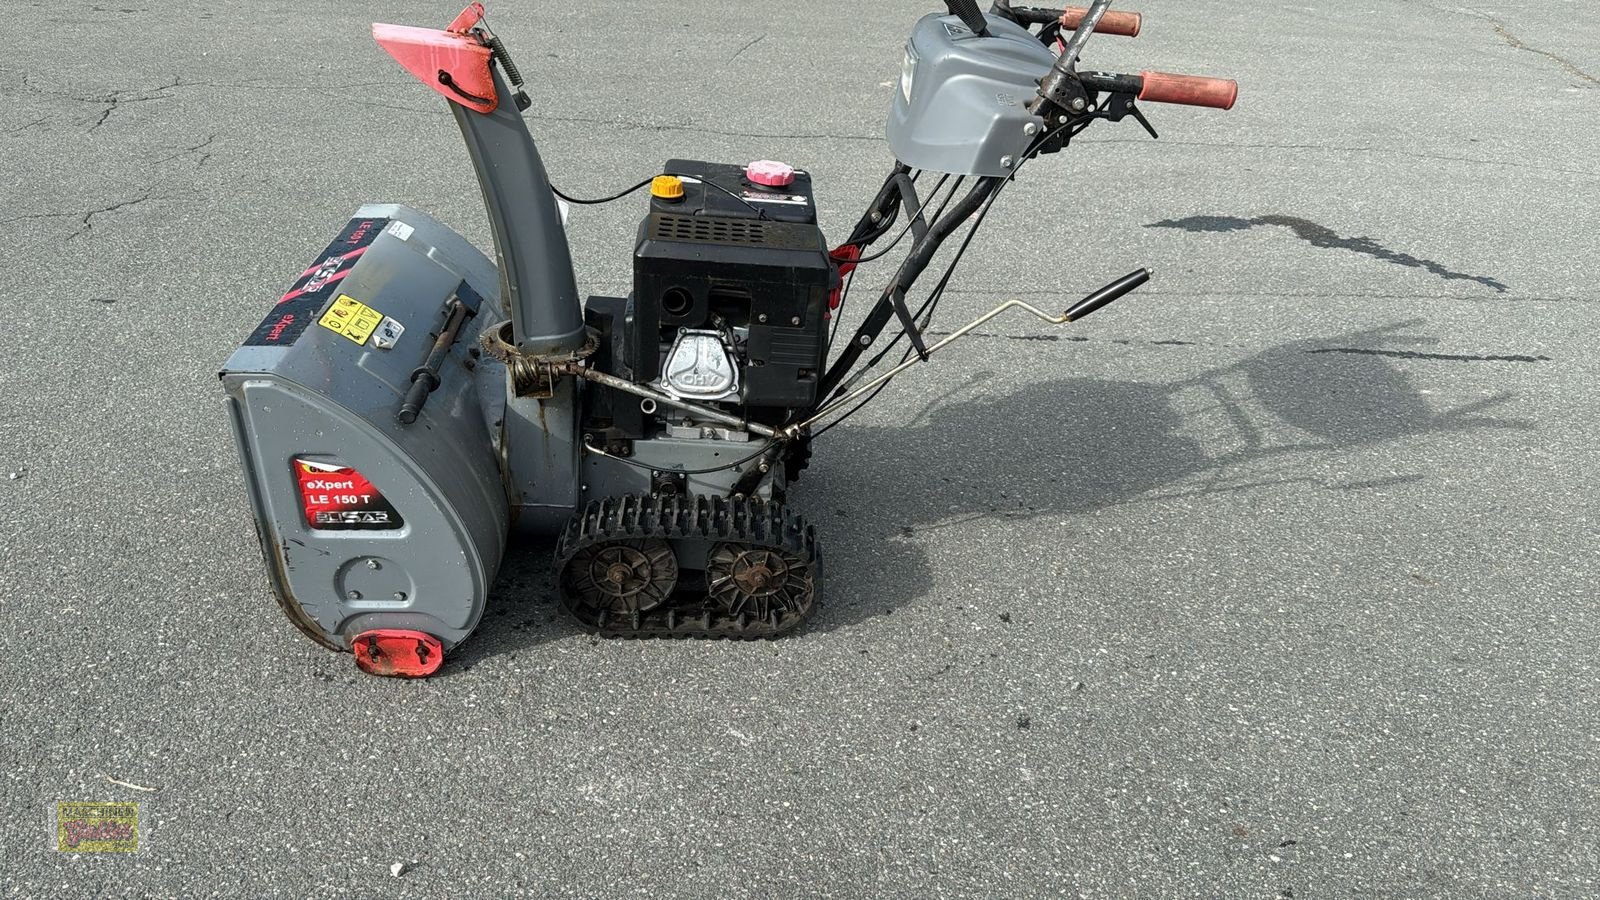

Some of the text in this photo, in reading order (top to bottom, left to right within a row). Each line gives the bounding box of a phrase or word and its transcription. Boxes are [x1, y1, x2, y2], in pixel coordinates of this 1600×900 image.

[265, 314, 295, 341] eXpert
[681, 373, 719, 387] OHV
[306, 480, 354, 491] eXpert
[310, 495, 371, 504] LE 150 T
